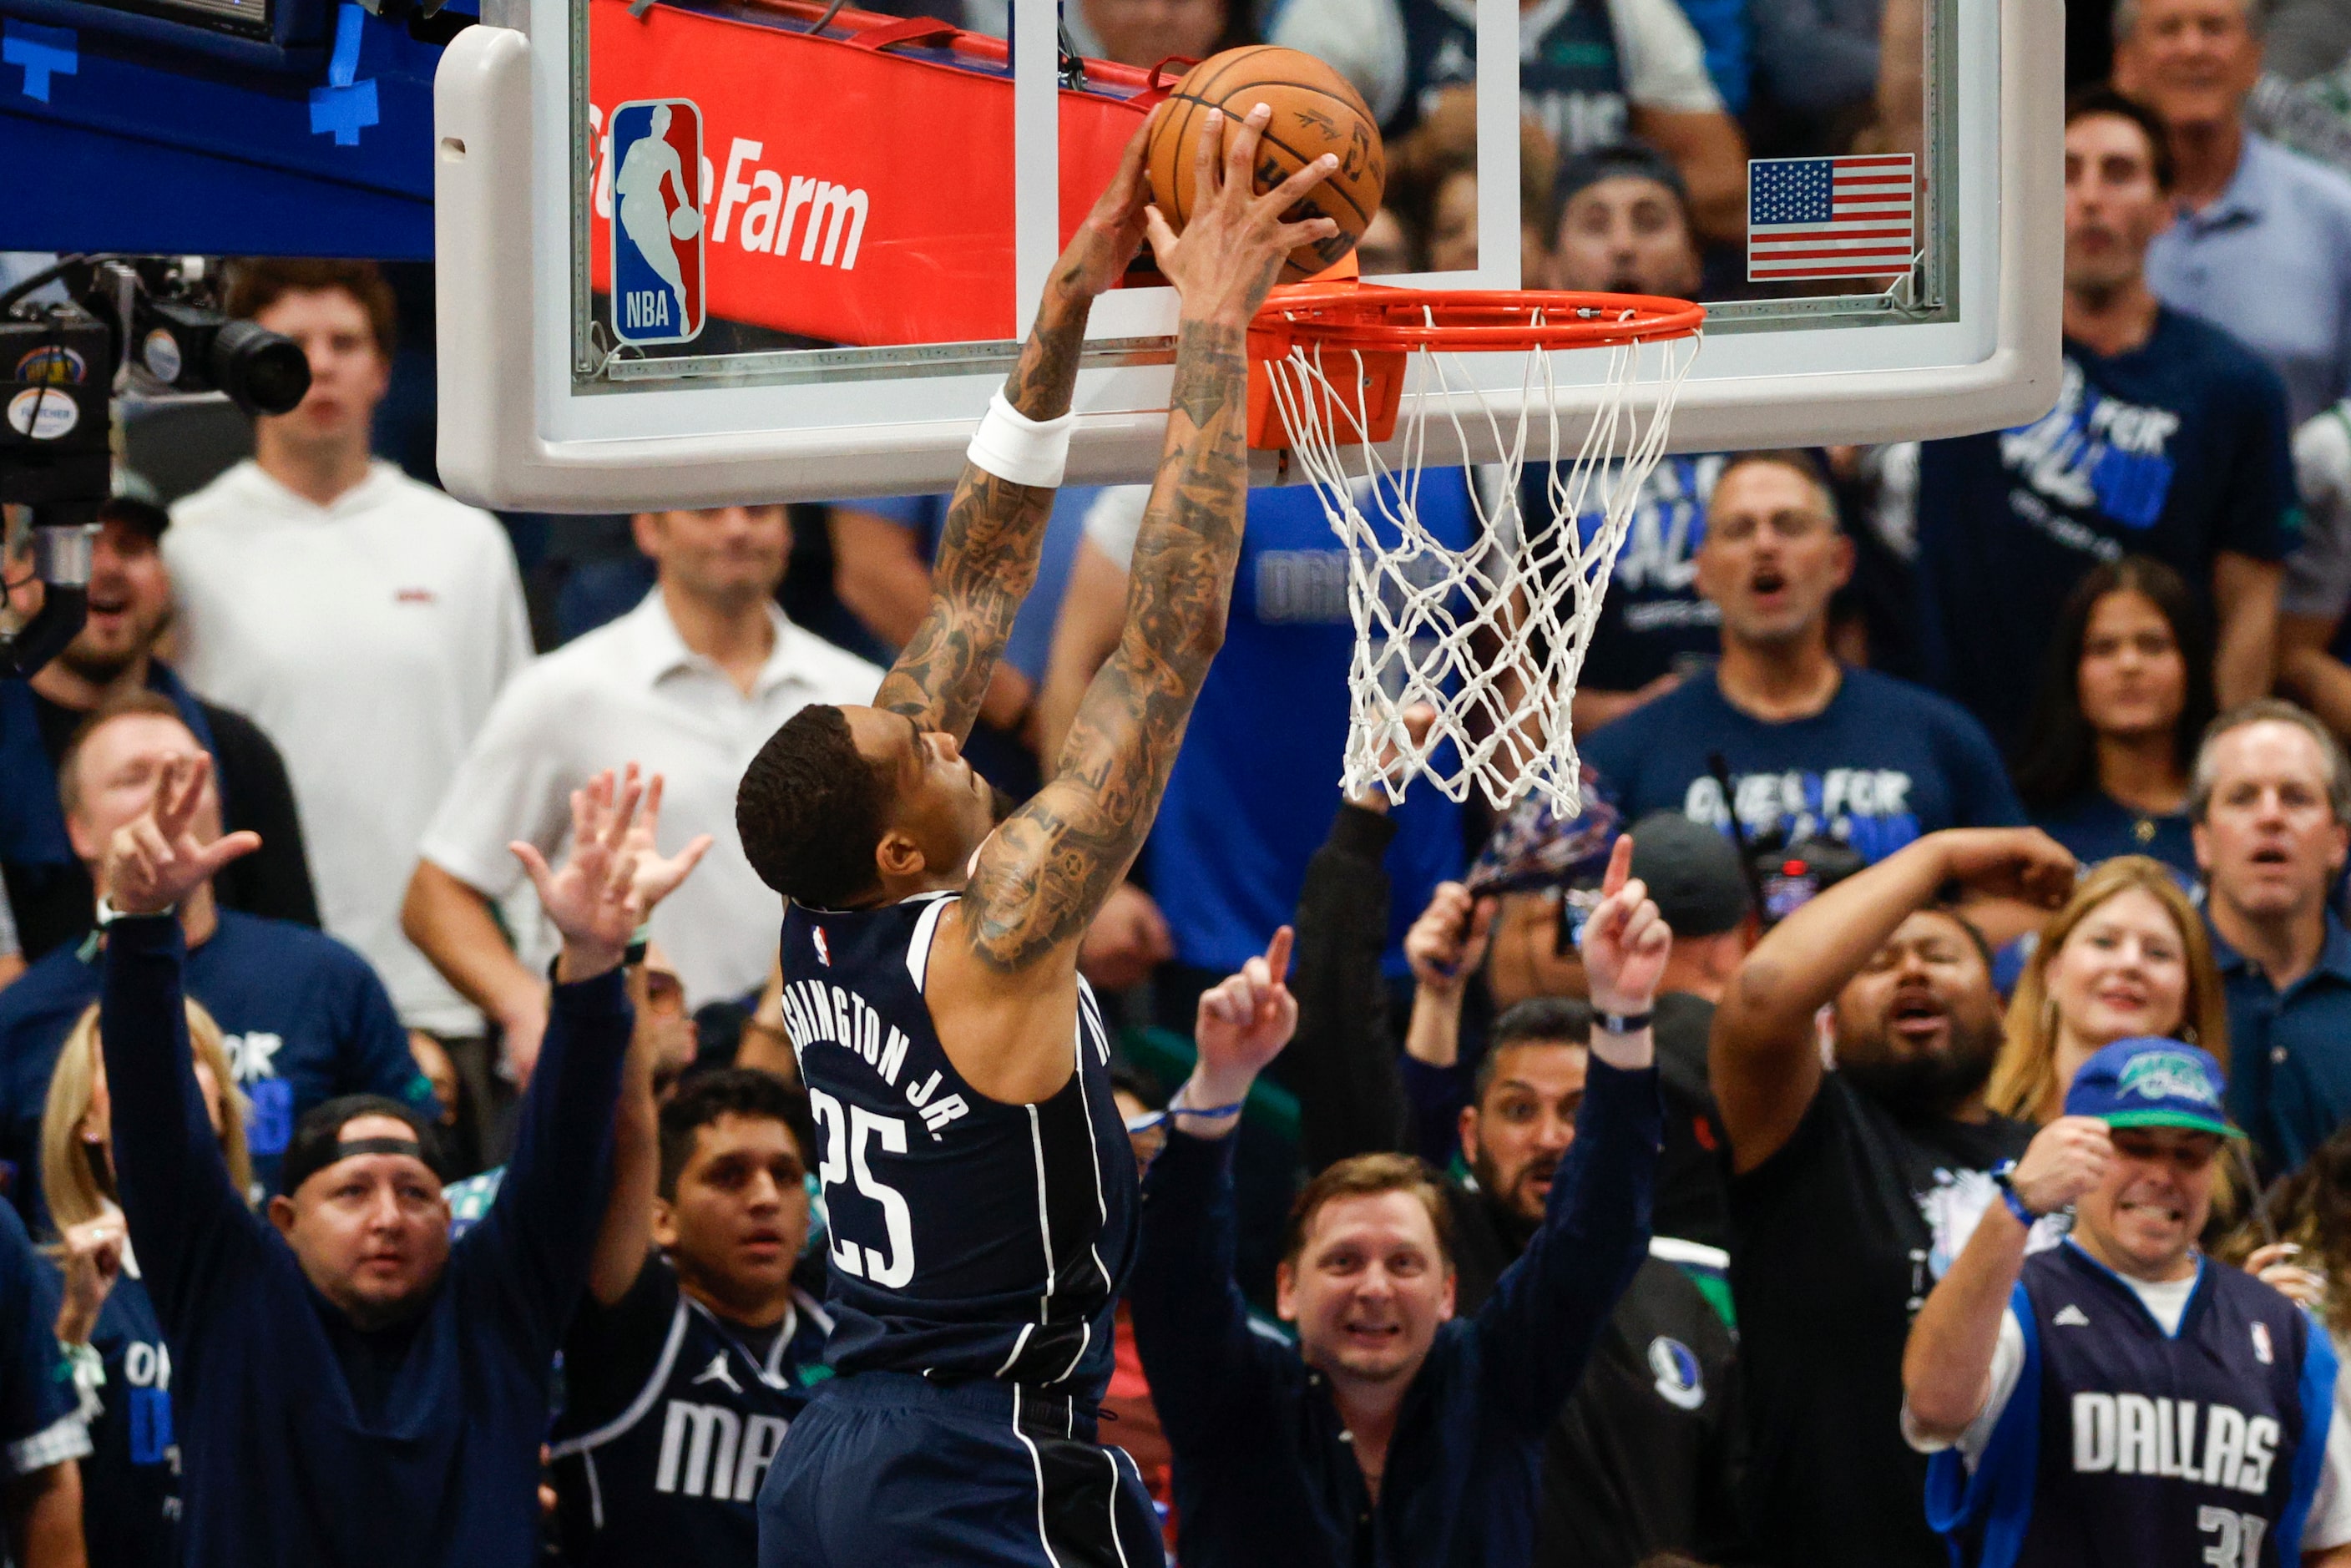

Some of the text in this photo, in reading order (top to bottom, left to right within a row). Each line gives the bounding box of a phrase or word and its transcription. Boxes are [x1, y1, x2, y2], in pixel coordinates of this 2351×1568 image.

[711, 136, 869, 271] Farm
[627, 290, 669, 328] NBA
[781, 979, 969, 1142] SHINGTON JR.
[809, 1087, 915, 1289] 25
[2072, 1392, 2280, 1495] DALLAS
